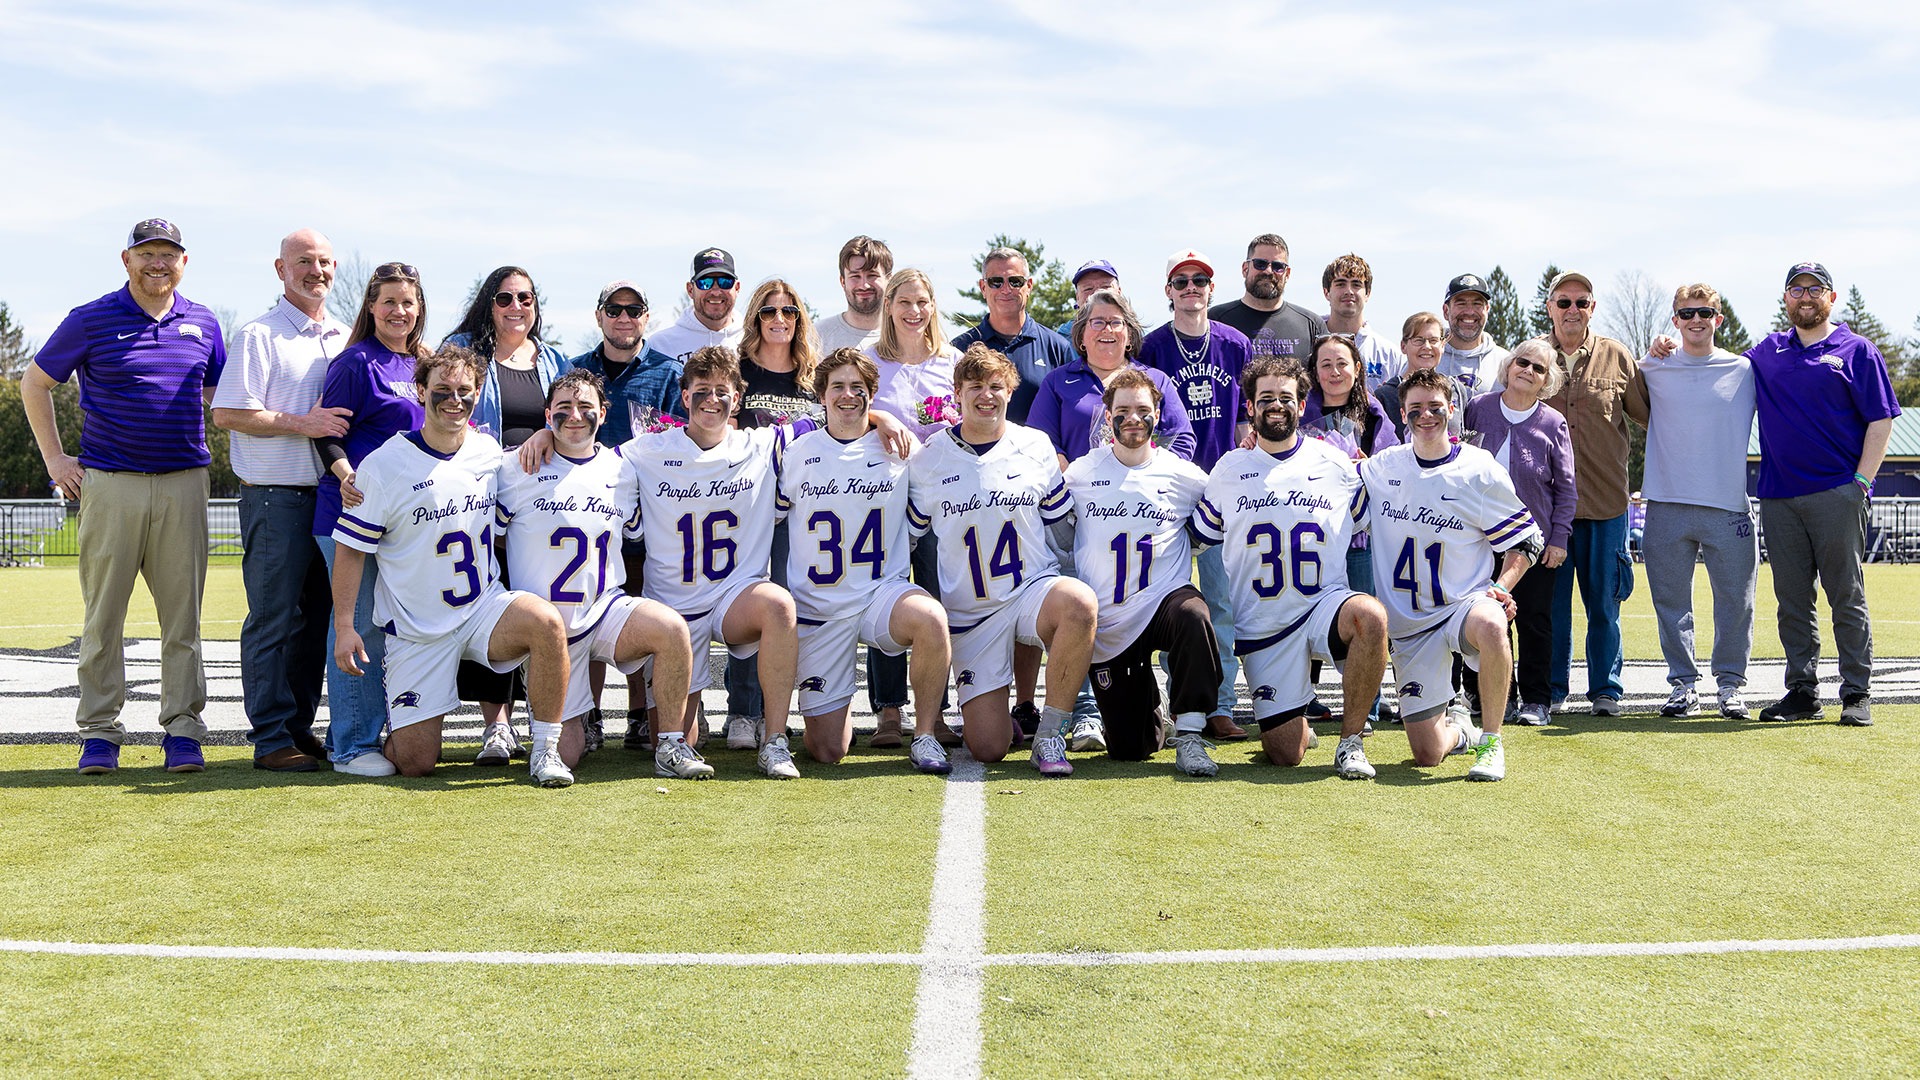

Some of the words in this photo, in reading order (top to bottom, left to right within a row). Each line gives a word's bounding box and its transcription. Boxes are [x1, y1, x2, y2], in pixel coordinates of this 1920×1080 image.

[1179, 363, 1232, 387] MICHAEL'S
[1187, 406, 1222, 421] OLLEGE
[656, 481, 701, 502] Purple
[706, 477, 754, 500] Knights
[801, 479, 839, 499] Purple
[843, 477, 894, 500] Knights
[1236, 491, 1279, 513] Purple
[1283, 490, 1333, 514] Knights
[412, 499, 458, 525] Purple
[533, 496, 577, 516] Purple
[941, 494, 981, 518] Purple
[985, 490, 1034, 513] Knights
[1085, 502, 1128, 521] Purple
[1381, 501, 1410, 522] Purple
[1412, 506, 1465, 534] Knights
[1736, 523, 1751, 538] 42
[676, 507, 740, 586] 16
[806, 506, 887, 588] 34
[963, 518, 1026, 601] 14
[1246, 520, 1327, 601] 36
[435, 523, 495, 610] 31
[549, 526, 613, 606] 21
[1109, 531, 1157, 606] 11
[1392, 535, 1451, 613] 41
